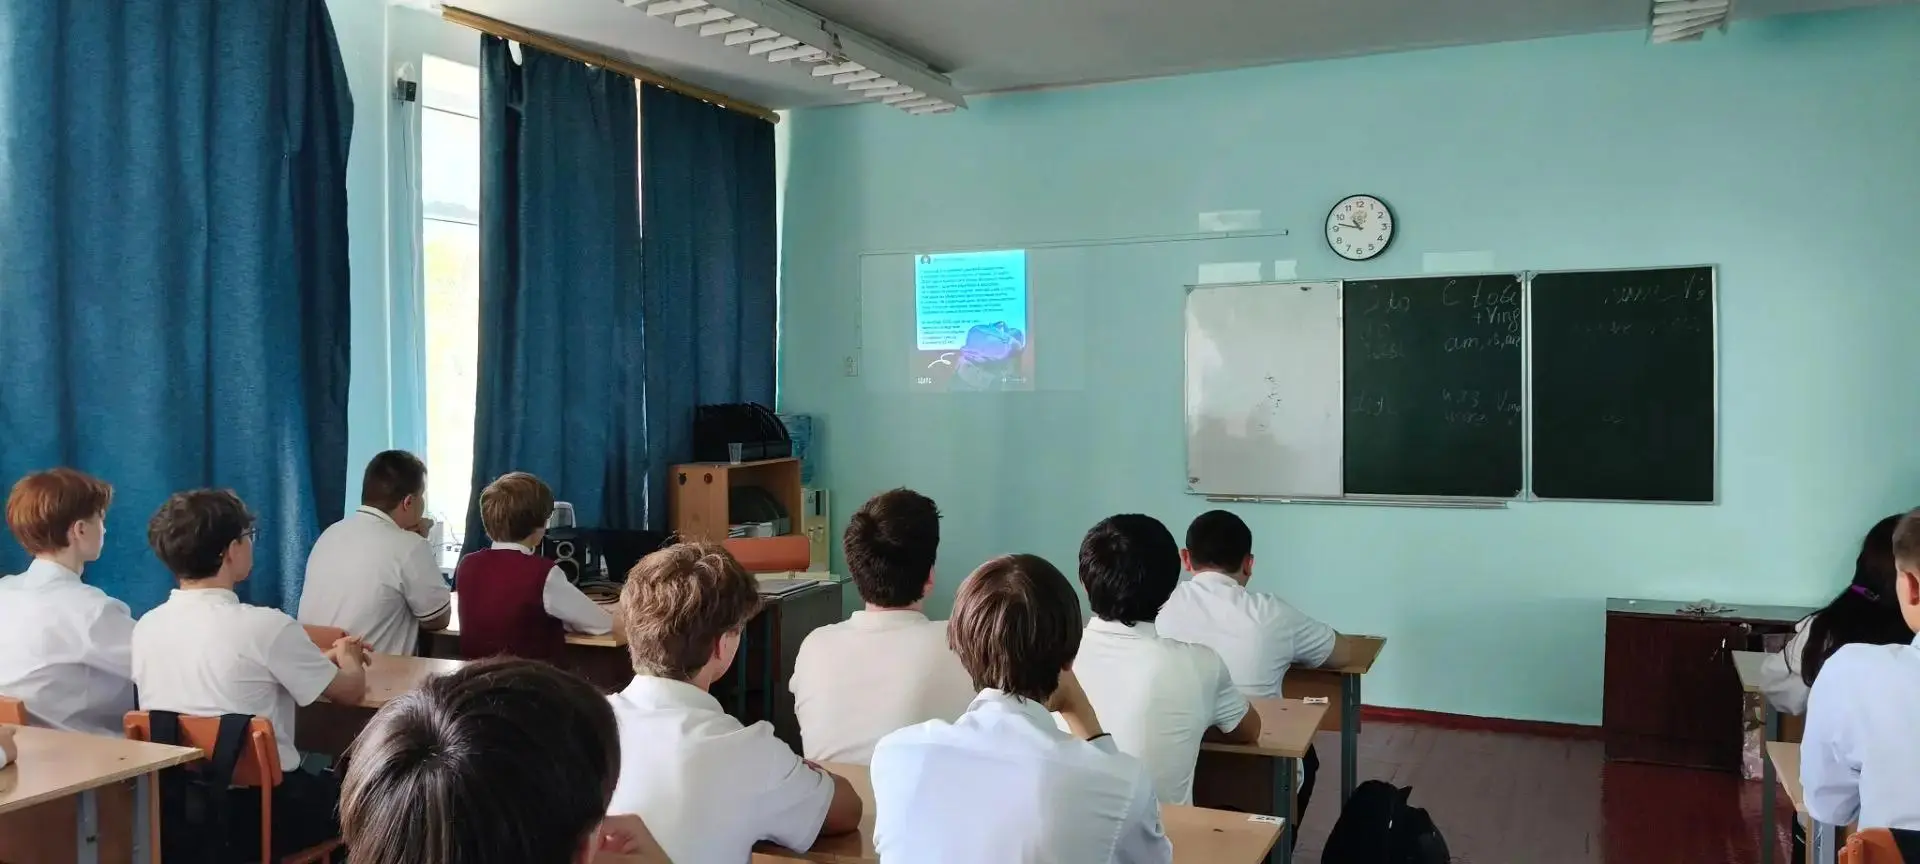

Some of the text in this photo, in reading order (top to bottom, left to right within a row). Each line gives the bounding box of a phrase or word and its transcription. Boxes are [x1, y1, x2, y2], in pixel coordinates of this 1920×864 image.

[1336, 213, 1345, 221] 10
[1377, 211, 1384, 219] 2
[1381, 223, 1388, 231] 3
[1336, 236, 1342, 244] 8
[1345, 244, 1351, 252] 7
[1356, 247, 1363, 255] 6
[1368, 243, 1375, 251] 5
